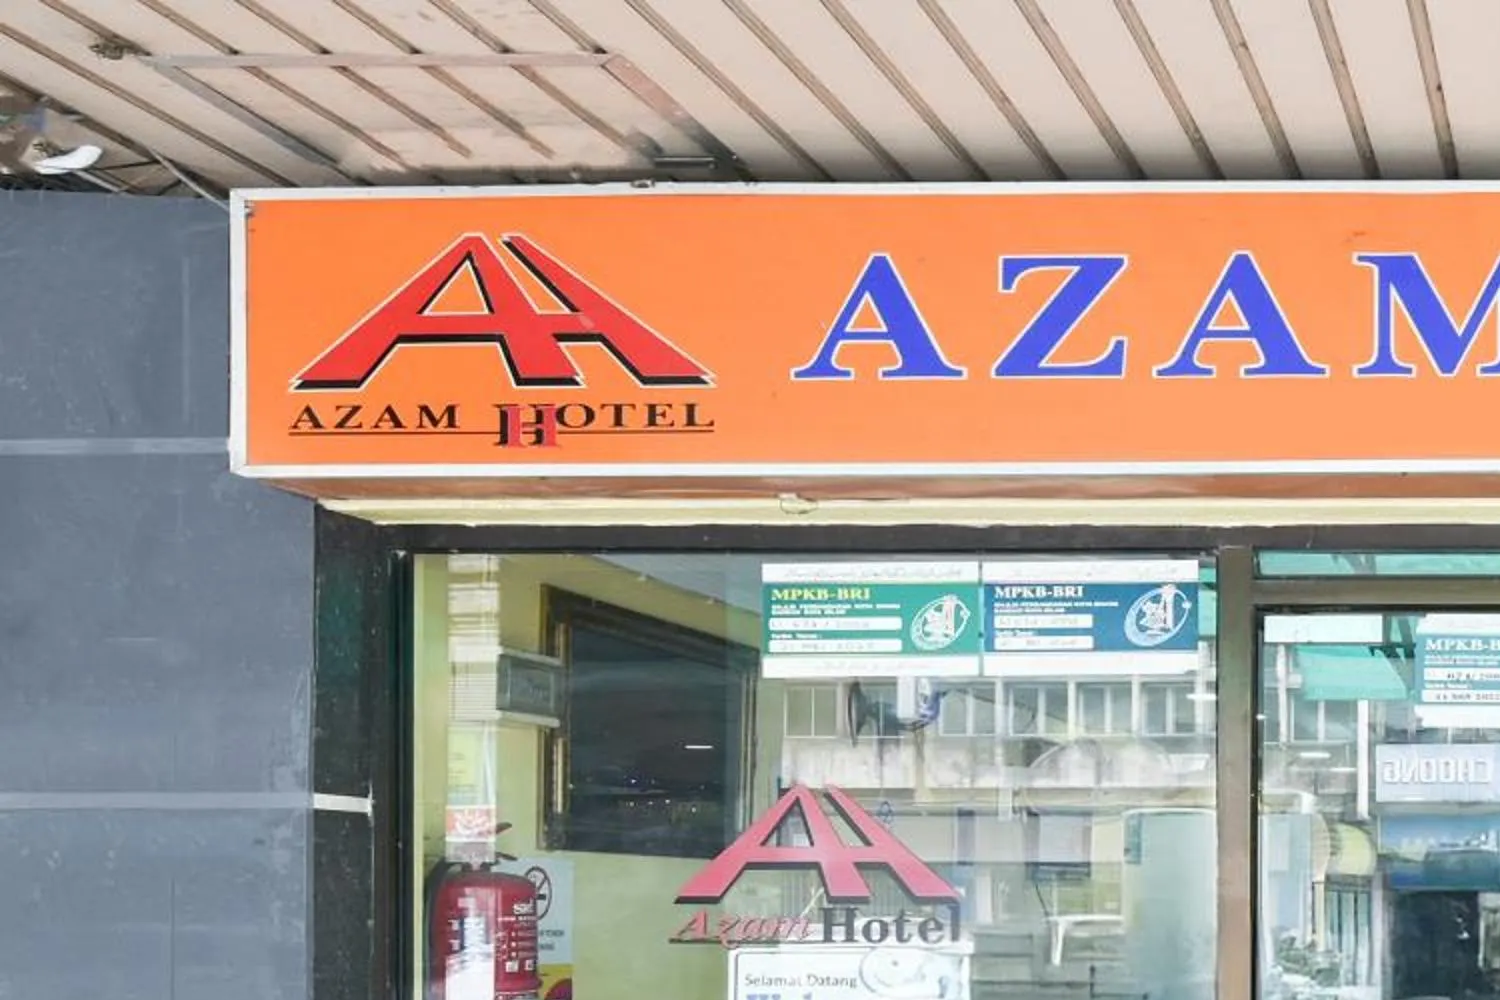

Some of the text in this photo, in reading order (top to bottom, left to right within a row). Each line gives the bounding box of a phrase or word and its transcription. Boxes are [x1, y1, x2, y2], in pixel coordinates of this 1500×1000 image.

[292, 403, 714, 447] AZAM HOTEL
[771, 587, 871, 601] MPKB-BRI
[994, 585, 1085, 599] MPKB-BRI
[675, 904, 962, 948] Azam Hotel
[807, 974, 858, 987] Datang
